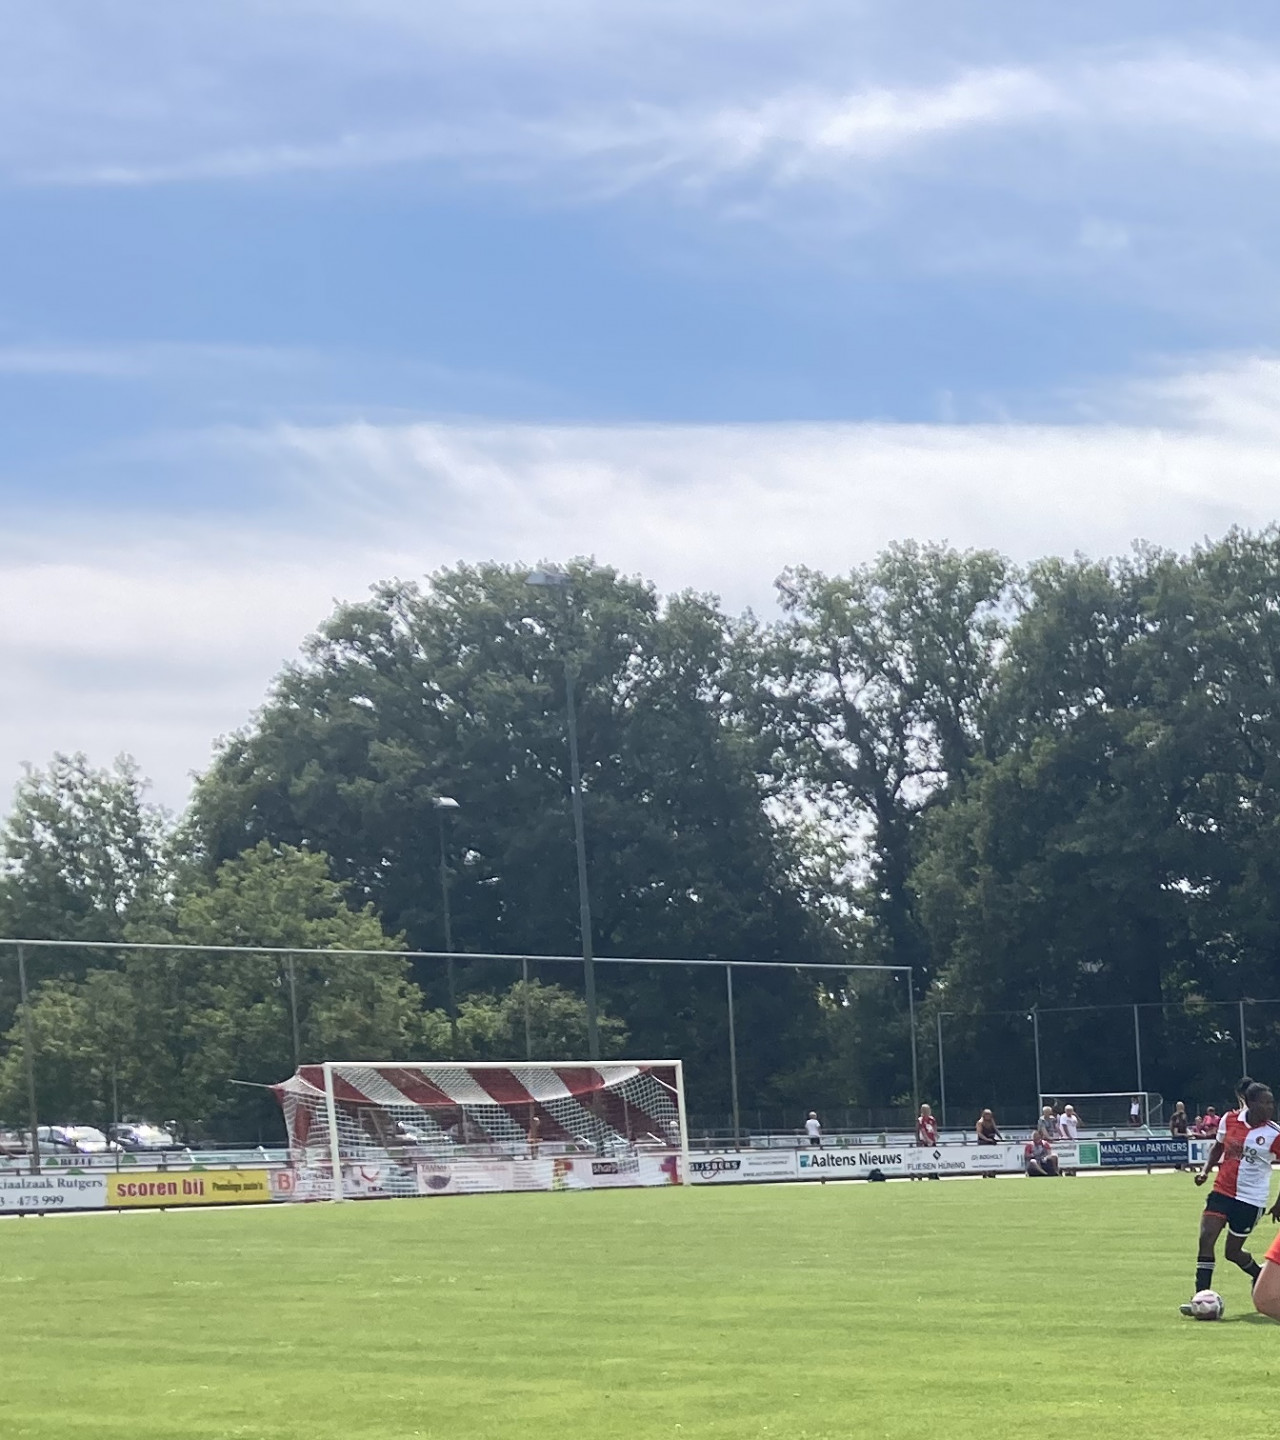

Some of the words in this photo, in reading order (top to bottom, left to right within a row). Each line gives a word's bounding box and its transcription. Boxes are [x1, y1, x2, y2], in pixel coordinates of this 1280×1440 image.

[1100, 1142, 1141, 1153] MANDEMA
[1146, 1142, 1187, 1153] PARTNERS
[811, 1152, 857, 1167] Aaltens
[859, 1151, 902, 1166] Nieuws
[907, 1162, 936, 1171] FLIESEN
[57, 1177, 103, 1191] Rutgers
[116, 1181, 178, 1197] scoren
[182, 1178, 205, 1196] bij
[42, 1194, 65, 1205] 999
